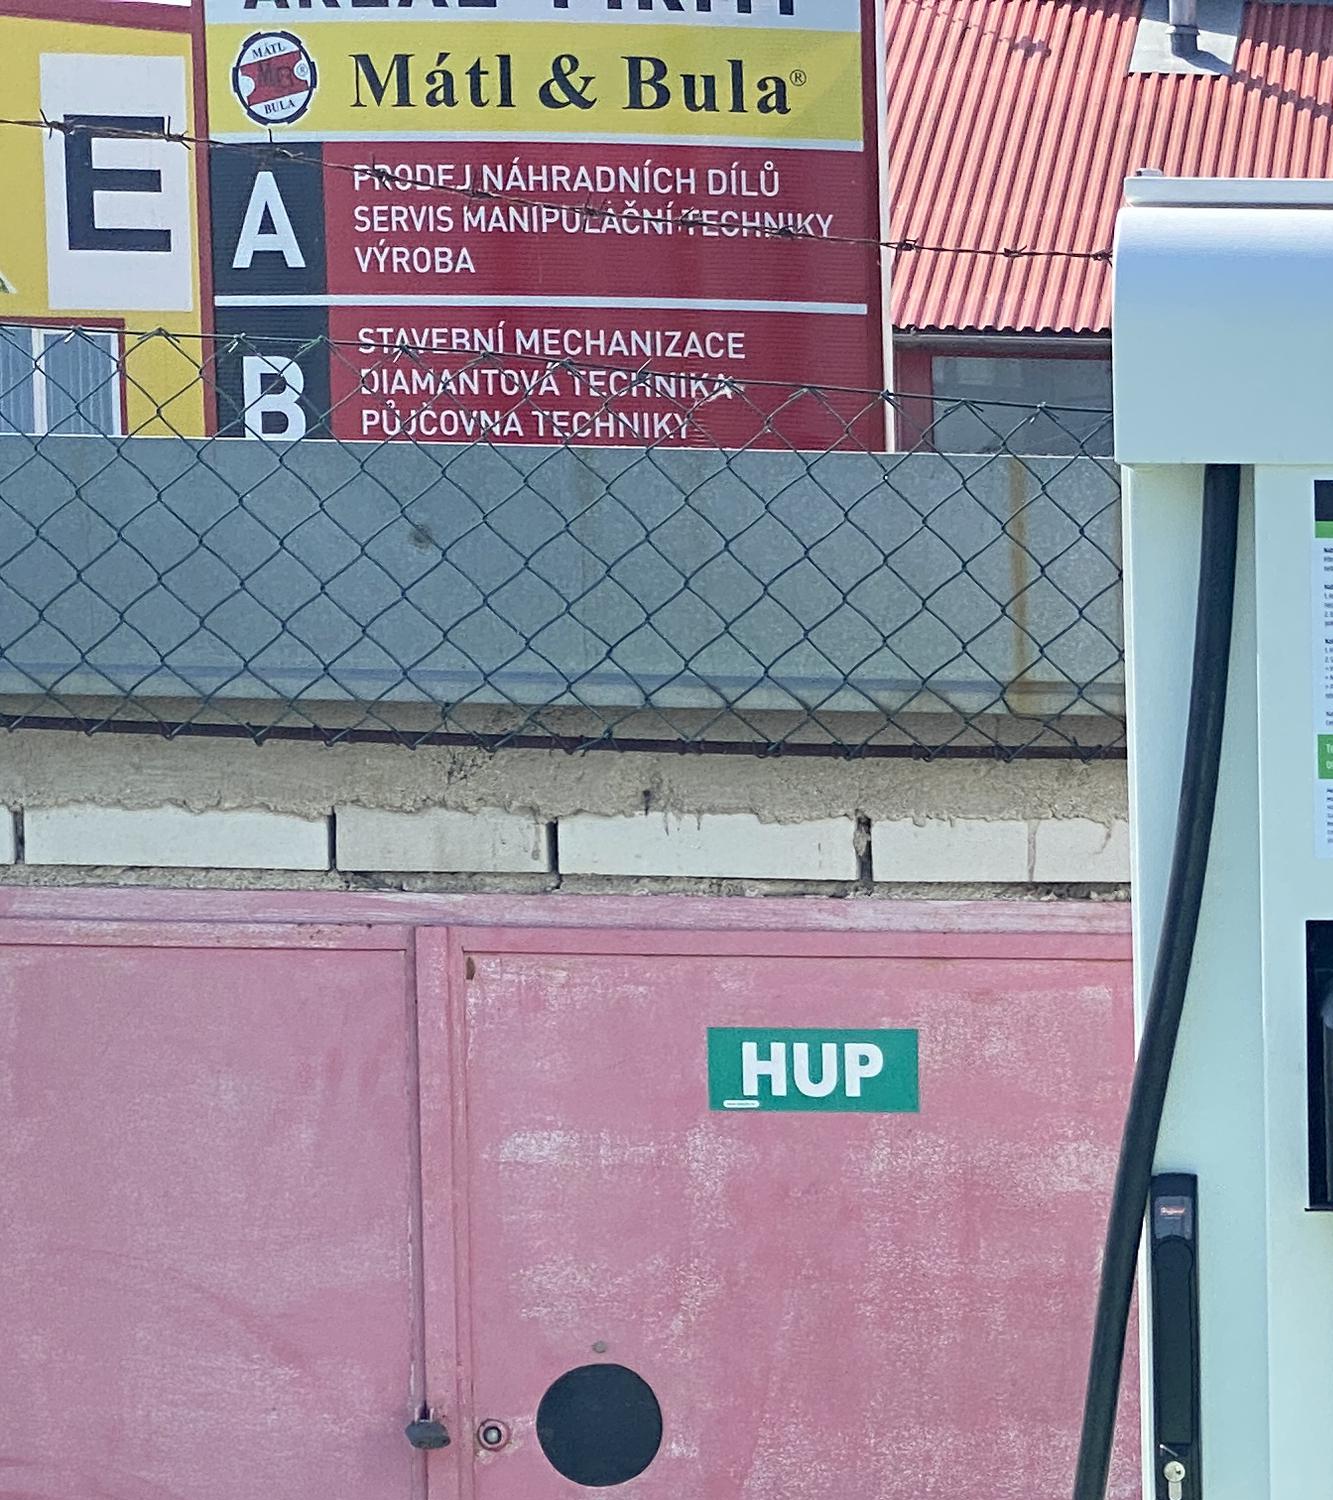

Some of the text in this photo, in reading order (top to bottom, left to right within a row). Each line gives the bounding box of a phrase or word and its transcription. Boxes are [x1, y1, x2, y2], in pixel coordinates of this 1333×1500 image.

[350, 52, 516, 108] Mátl
[538, 53, 597, 110] &
[263, 99, 296, 116] BULA
[63, 114, 172, 252] E
[353, 157, 780, 198] PRODEJ NÁHRADNÍCH DÍLŮ
[231, 170, 306, 269] A
[353, 200, 833, 239] SERVIS MANIPULAČNÍ TECHNIKY
[354, 238, 476, 274] VÝROBA
[358, 321, 746, 360] STAVEBNÍ MECHANIZACE
[242, 355, 306, 439] B
[360, 361, 734, 399] DIAMANTOVÁ TECHNIKA
[361, 400, 690, 439] PŮJČOVNA TECHNIKY
[741, 1041, 884, 1098] HUP
